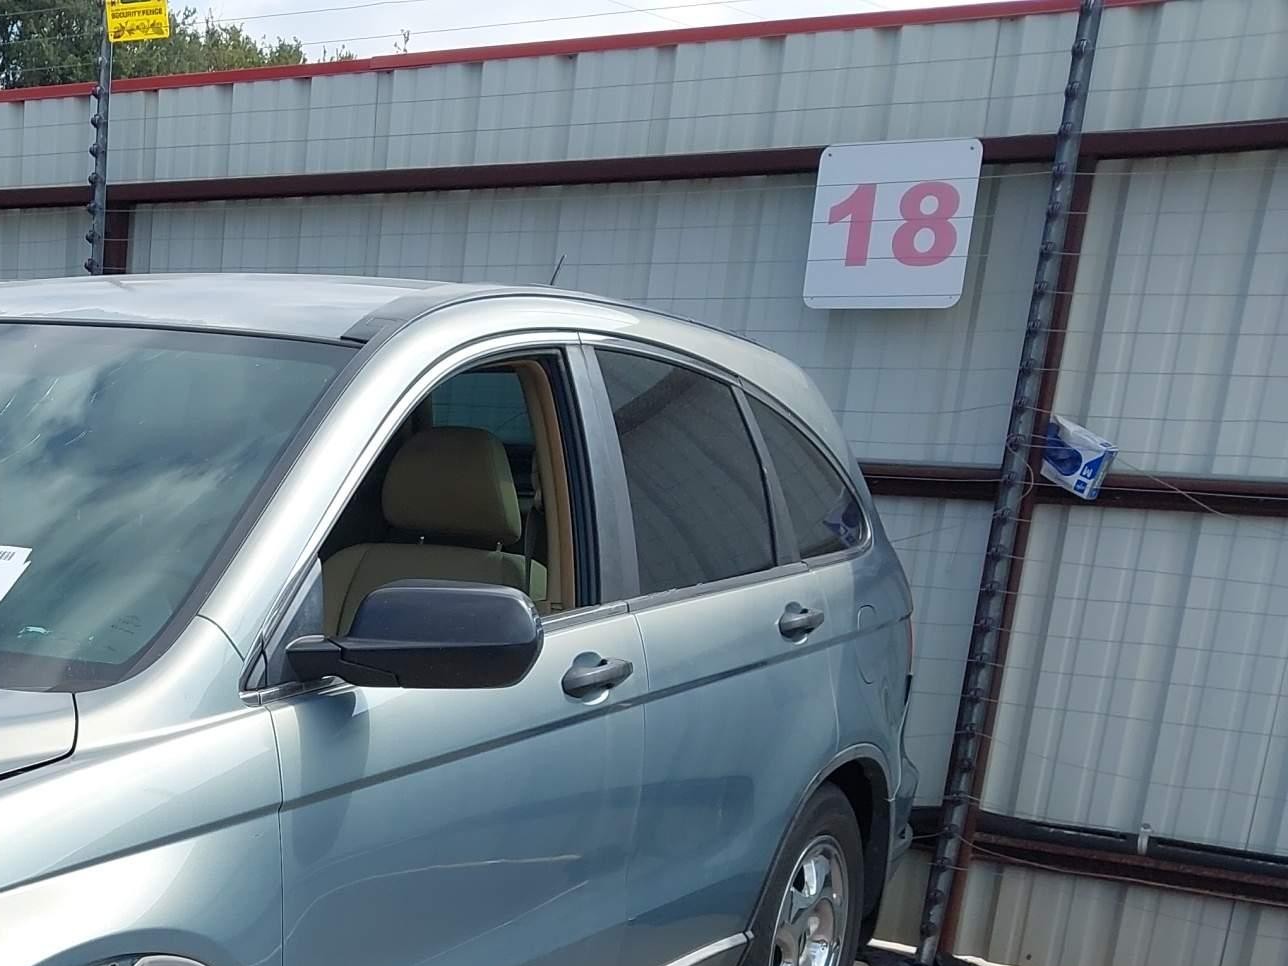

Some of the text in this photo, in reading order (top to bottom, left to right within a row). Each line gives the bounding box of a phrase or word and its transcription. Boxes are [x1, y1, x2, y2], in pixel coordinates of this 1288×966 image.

[111, 10, 141, 19] SECURITY
[142, 7, 163, 16] FENCE
[827, 181, 961, 267] 18
